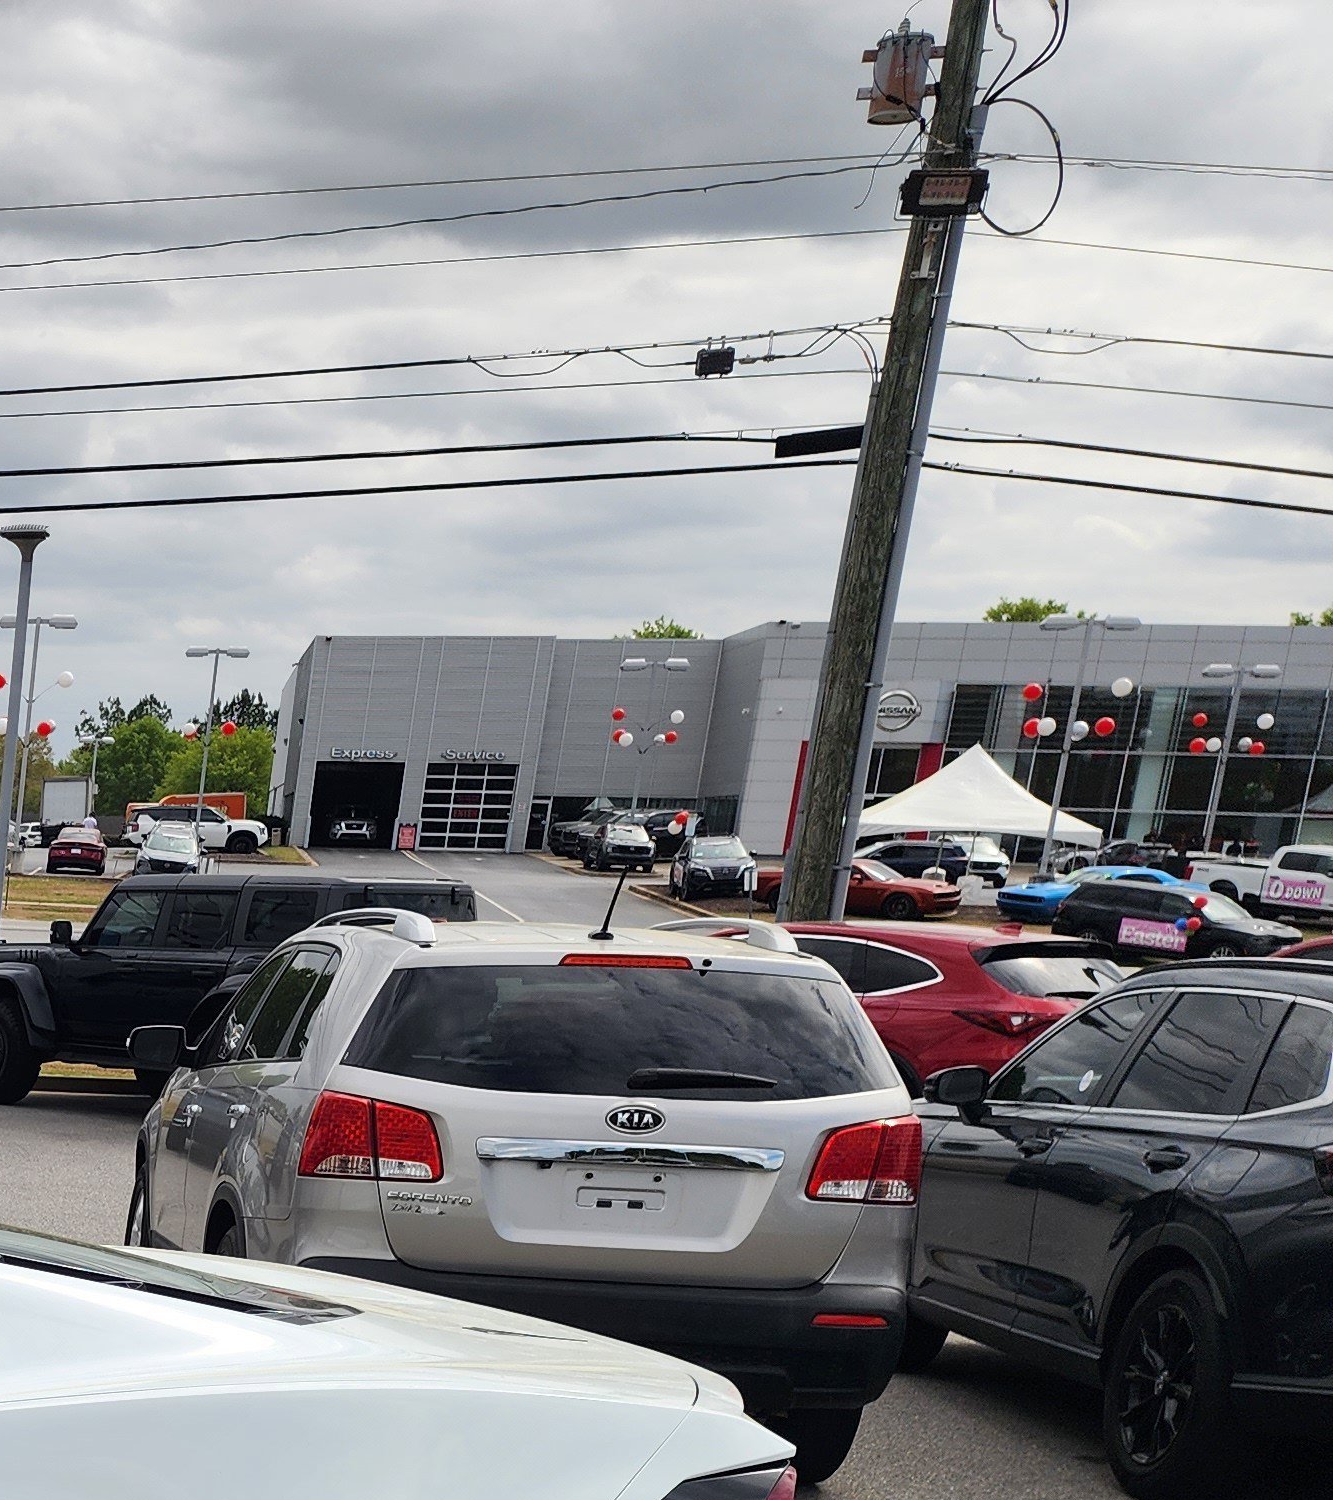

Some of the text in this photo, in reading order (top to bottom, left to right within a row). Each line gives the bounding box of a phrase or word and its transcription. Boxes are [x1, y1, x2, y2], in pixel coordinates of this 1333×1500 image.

[331, 747, 505, 760] Express Service
[1285, 886, 1323, 900] DOWN
[1121, 926, 1185, 949] Easter
[616, 1112, 654, 1127] KIA
[387, 1190, 473, 1206] SORENTO
